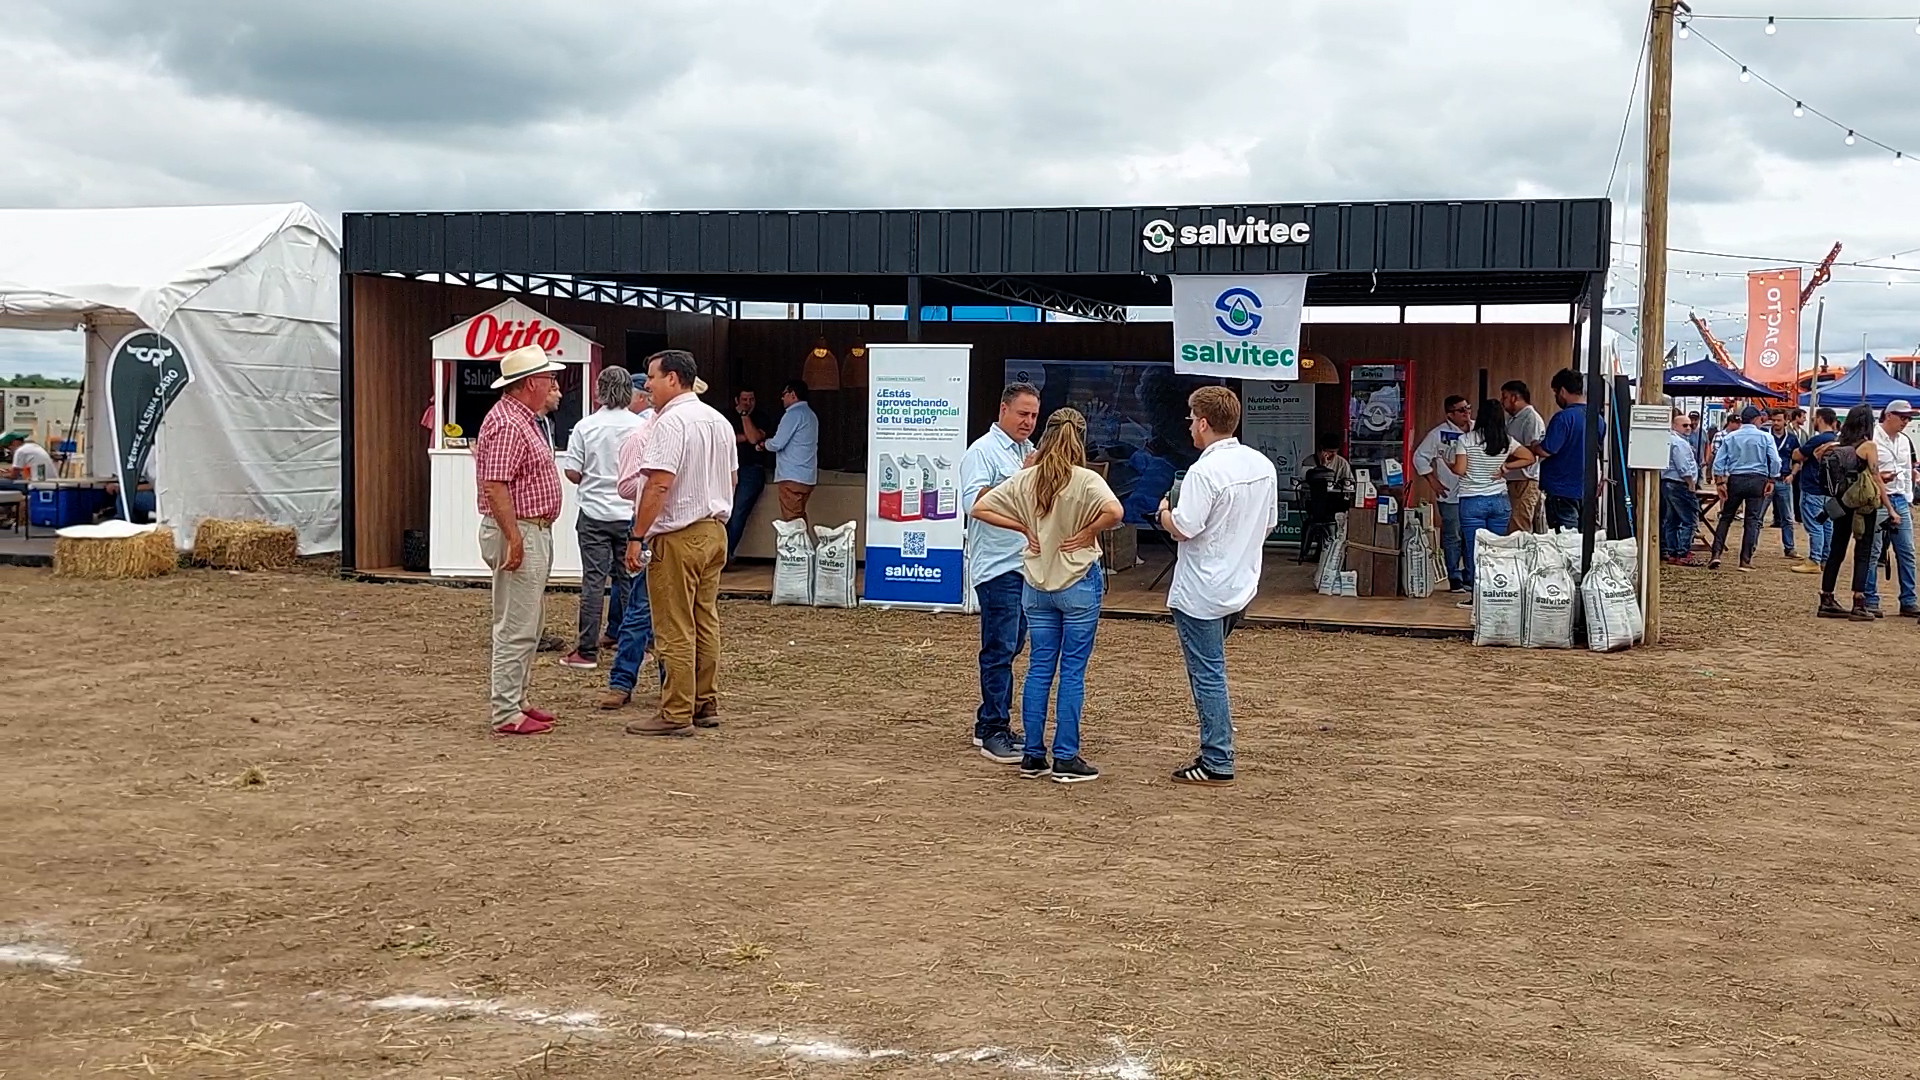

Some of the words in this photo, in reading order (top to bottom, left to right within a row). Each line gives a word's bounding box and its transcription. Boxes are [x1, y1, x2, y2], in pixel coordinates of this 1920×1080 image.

[1180, 216, 1310, 245] salvitec
[1181, 341, 1295, 367] salvitec
[876, 388, 912, 399] ¿Estás
[139, 398, 160, 433] ALSINA
[154, 369, 179, 397] CARO
[876, 398, 949, 409] aprovechando
[1247, 396, 1281, 404] Nutrición
[876, 407, 900, 416] todo
[902, 407, 911, 416] el
[913, 407, 960, 417] potencial
[876, 415, 889, 424] de
[891, 416, 902, 424] tu
[904, 416, 937, 425] suelo?
[885, 563, 942, 579] salvitec
[1483, 589, 1519, 598] salvitec
[1535, 596, 1571, 605] salvitec
